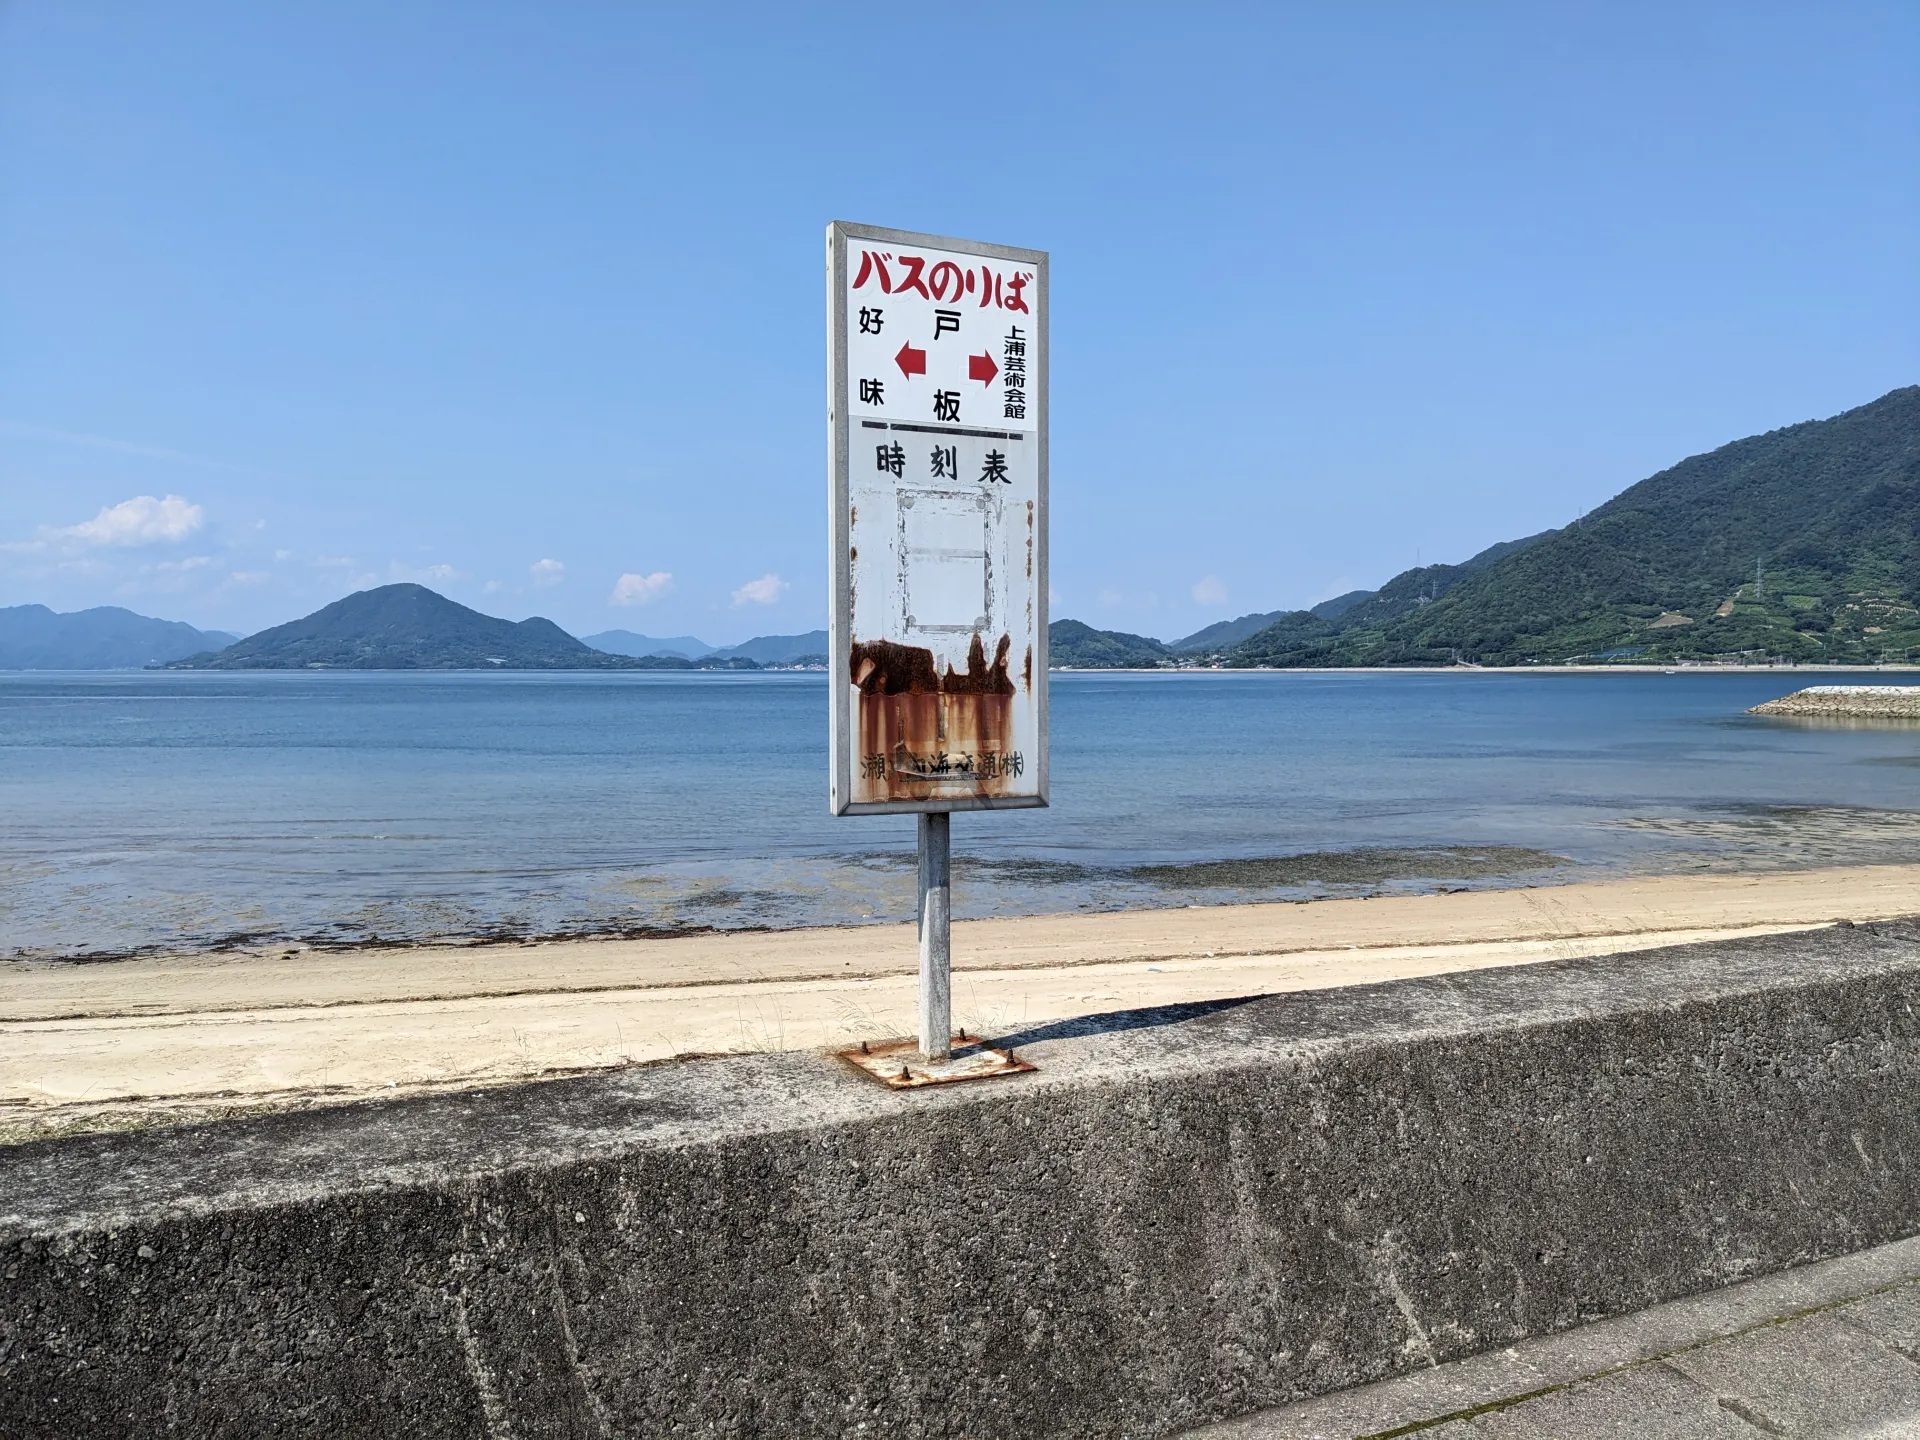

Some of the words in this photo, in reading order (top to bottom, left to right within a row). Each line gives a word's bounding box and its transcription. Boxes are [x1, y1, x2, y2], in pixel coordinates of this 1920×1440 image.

[853, 250, 1034, 315] バスのりば
[1003, 325, 1027, 420] 上浦芸術会館
[876, 439, 1012, 484] 時刻表
